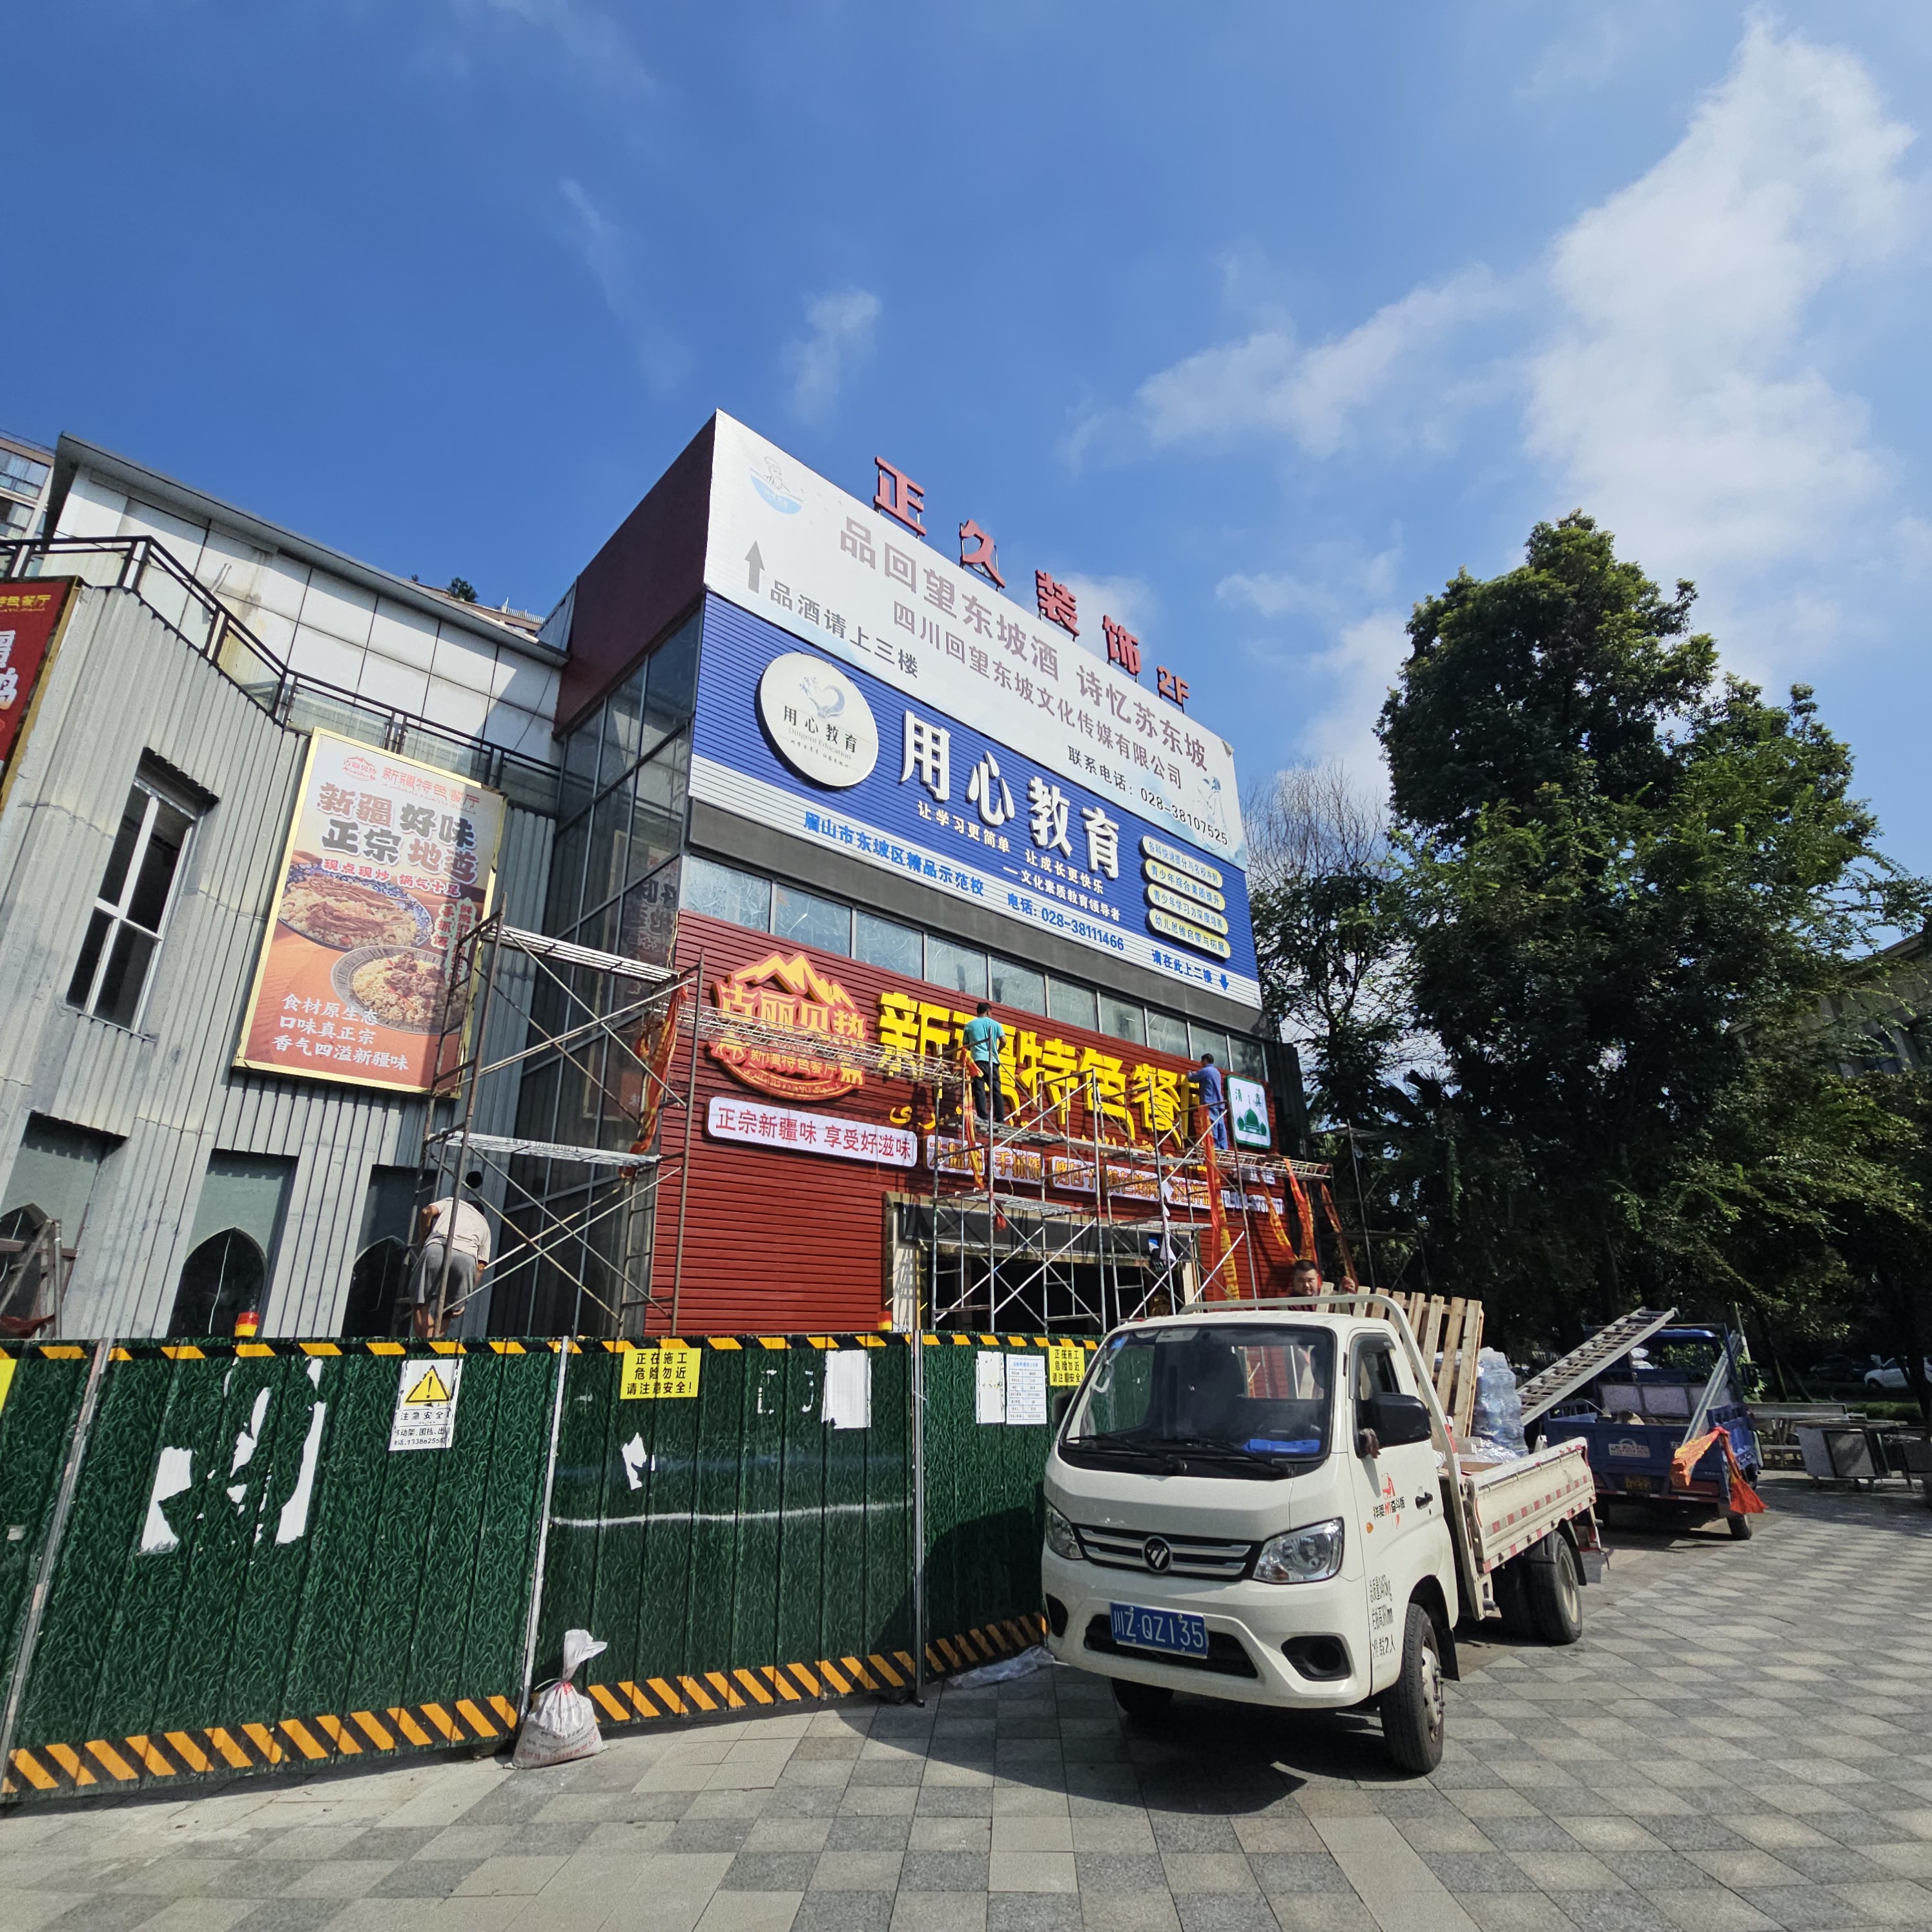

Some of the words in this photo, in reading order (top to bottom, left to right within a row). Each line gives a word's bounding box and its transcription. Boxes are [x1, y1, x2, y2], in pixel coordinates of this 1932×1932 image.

[770, 580, 918, 678] 品酒请上三楼
[841, 517, 1058, 682] 品回望东坡酒
[1076, 665, 1207, 772] 诗忆苏东坡
[894, 601, 1182, 790] 四川回望东坡文化传媒有限公司
[784, 705, 858, 753] 用心教育
[788, 727, 817, 743] Diligent
[819, 739, 852, 761] Education
[382, 766, 480, 809] 新疆特色餐厅
[900, 710, 1119, 879] 用心教育
[317, 782, 392, 827] 新疆
[400, 803, 475, 847] 好味
[322, 819, 402, 863] 正宗
[407, 839, 478, 882] 地道
[917, 801, 1010, 854] 让学习更简单
[1025, 849, 1104, 895] 让成长更快乐
[323, 859, 391, 881] 现点现炒
[398, 876, 461, 896] 锅气十足
[804, 811, 984, 897] 眉山市东坡区精品示范校
[1151, 949, 1212, 984] 请在此上二楼
[1151, 864, 1220, 906] 青少年综合素质提升
[1153, 889, 1223, 929] 青少年学习力深度培养
[281, 993, 378, 1025] 食材原生态
[280, 1016, 376, 1045] 口味真正宗
[272, 1034, 409, 1071] 香气四溢新疆味
[750, 1049, 838, 1079] 新疆特色餐厅
[716, 1107, 817, 1144] 正宗新疆味
[824, 1125, 911, 1160] 享受好滋味
[634, 1366, 687, 1380] 危险勿近
[635, 1351, 688, 1364] 正在施工
[400, 1411, 444, 1421] 注意安全
